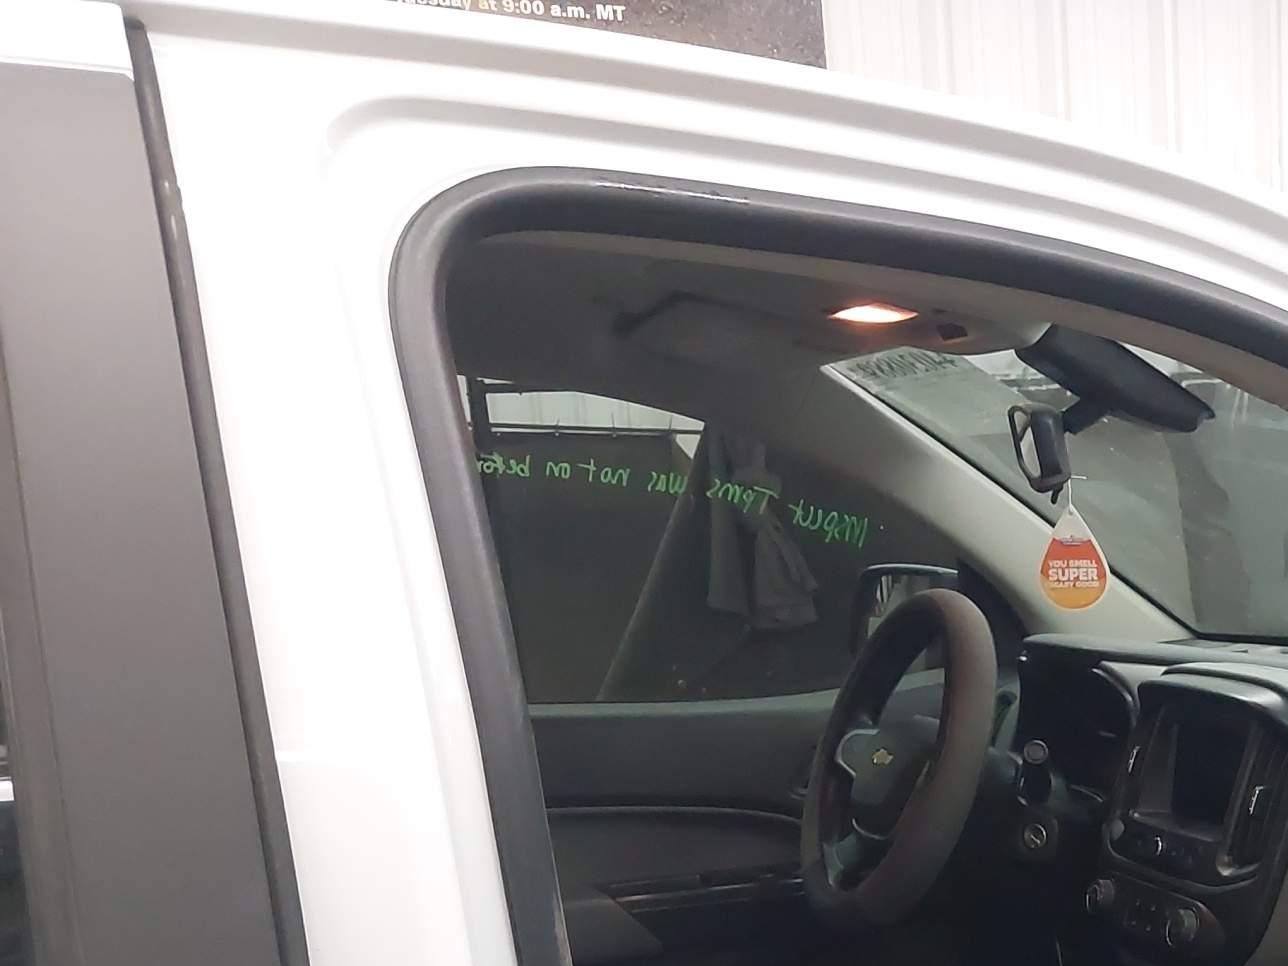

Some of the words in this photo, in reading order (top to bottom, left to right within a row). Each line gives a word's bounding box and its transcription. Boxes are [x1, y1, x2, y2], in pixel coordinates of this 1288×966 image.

[477, 0, 497, 11] at
[503, 0, 545, 15] 9:00
[550, 4, 590, 19] a.m.
[595, 4, 626, 21] MT
[1048, 560, 1067, 568] YOU
[1048, 568, 1098, 581] SUPER
